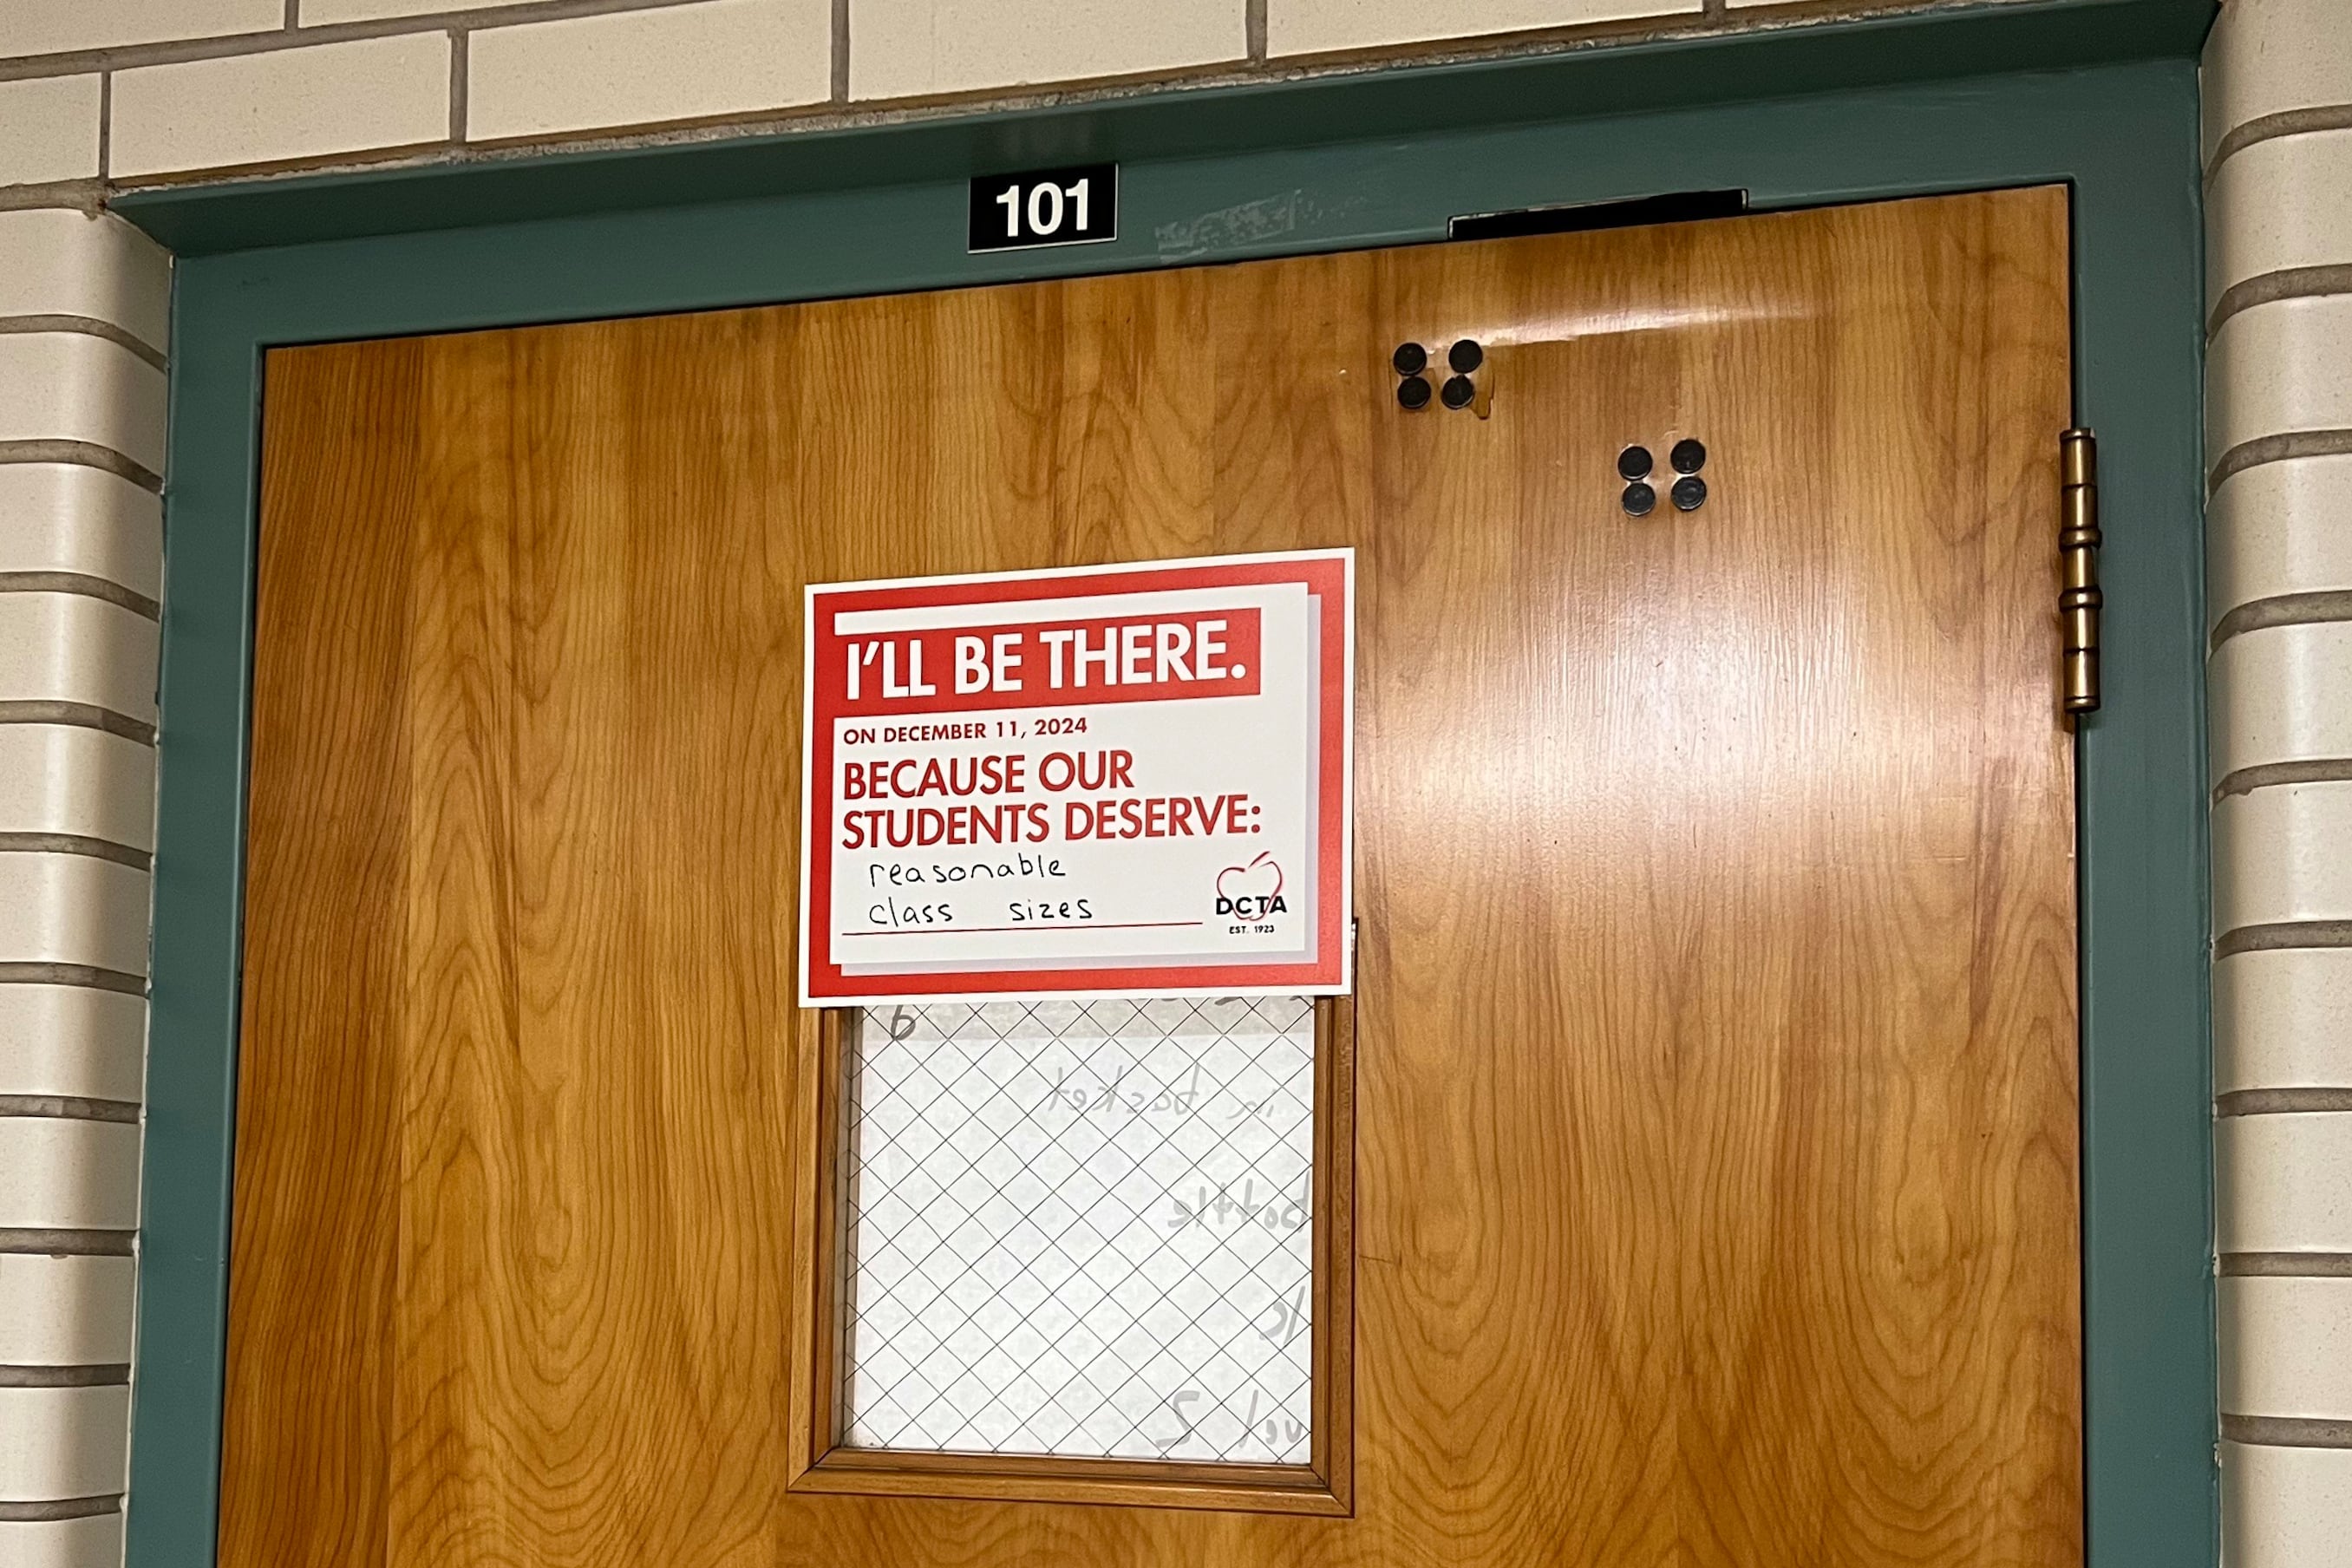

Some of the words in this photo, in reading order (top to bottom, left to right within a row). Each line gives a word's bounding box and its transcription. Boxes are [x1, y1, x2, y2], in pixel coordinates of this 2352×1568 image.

[996, 179, 1089, 238] 101
[846, 639, 937, 700] I'LL
[954, 632, 1023, 695] BE
[1039, 619, 1246, 689] THERE.
[843, 728, 876, 745] ON
[884, 722, 987, 743] DECEMBER
[996, 721, 1027, 740] 11,
[1035, 717, 1088, 736] 2024
[843, 755, 1026, 800] BECAUSE
[1038, 749, 1134, 793] OUR
[841, 802, 1050, 850] STUDENTS
[1064, 794, 1262, 841] DESERVE:
[869, 853, 1067, 888] reasonable
[868, 897, 954, 927] class
[1009, 897, 1094, 922] sizes
[1215, 895, 1288, 916] DCTA
[1228, 925, 1249, 934] EST.
[1254, 924, 1275, 933] 1923
